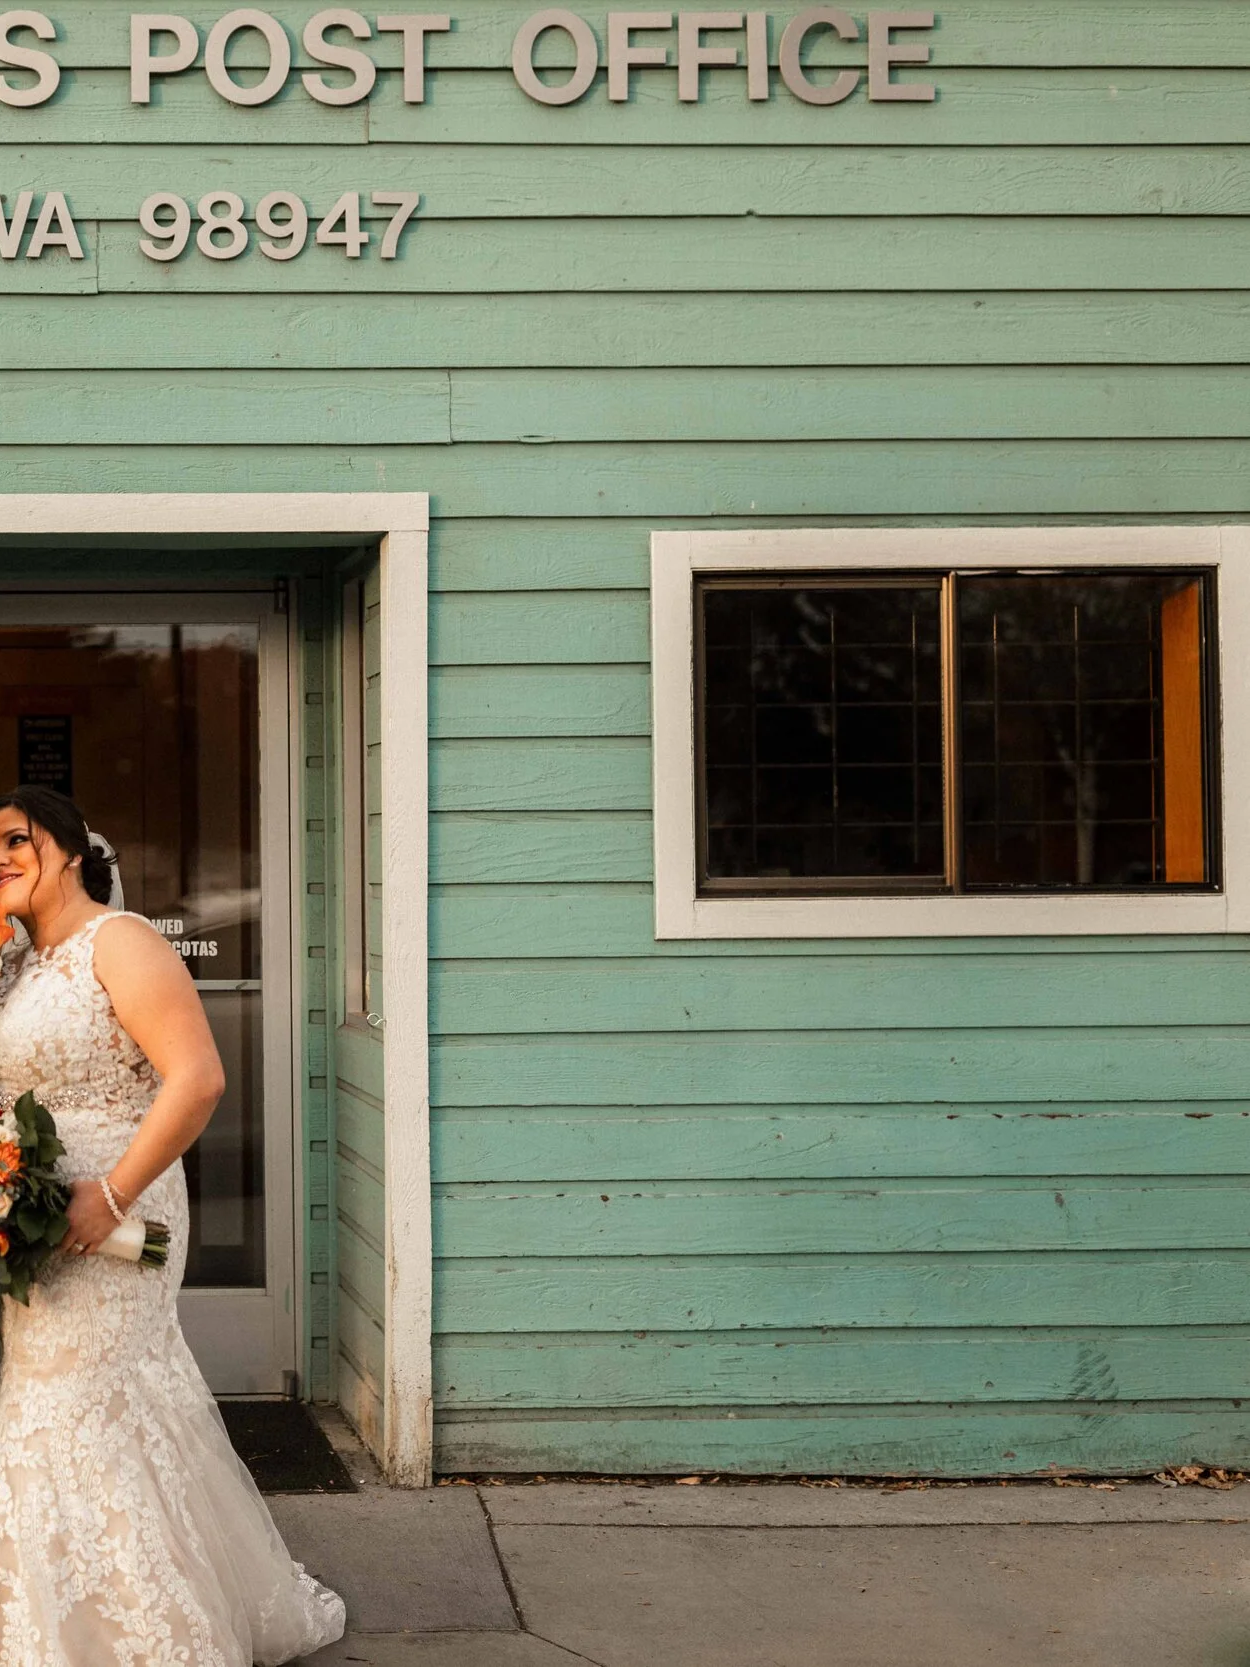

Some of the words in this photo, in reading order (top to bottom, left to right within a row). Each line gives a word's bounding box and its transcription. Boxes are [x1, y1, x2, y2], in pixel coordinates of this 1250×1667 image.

[129, 9, 451, 106] POST
[512, 7, 938, 106] OFFICE
[138, 190, 421, 262] 98947
[151, 918, 184, 935] WED
[171, 940, 218, 957] COTAS
